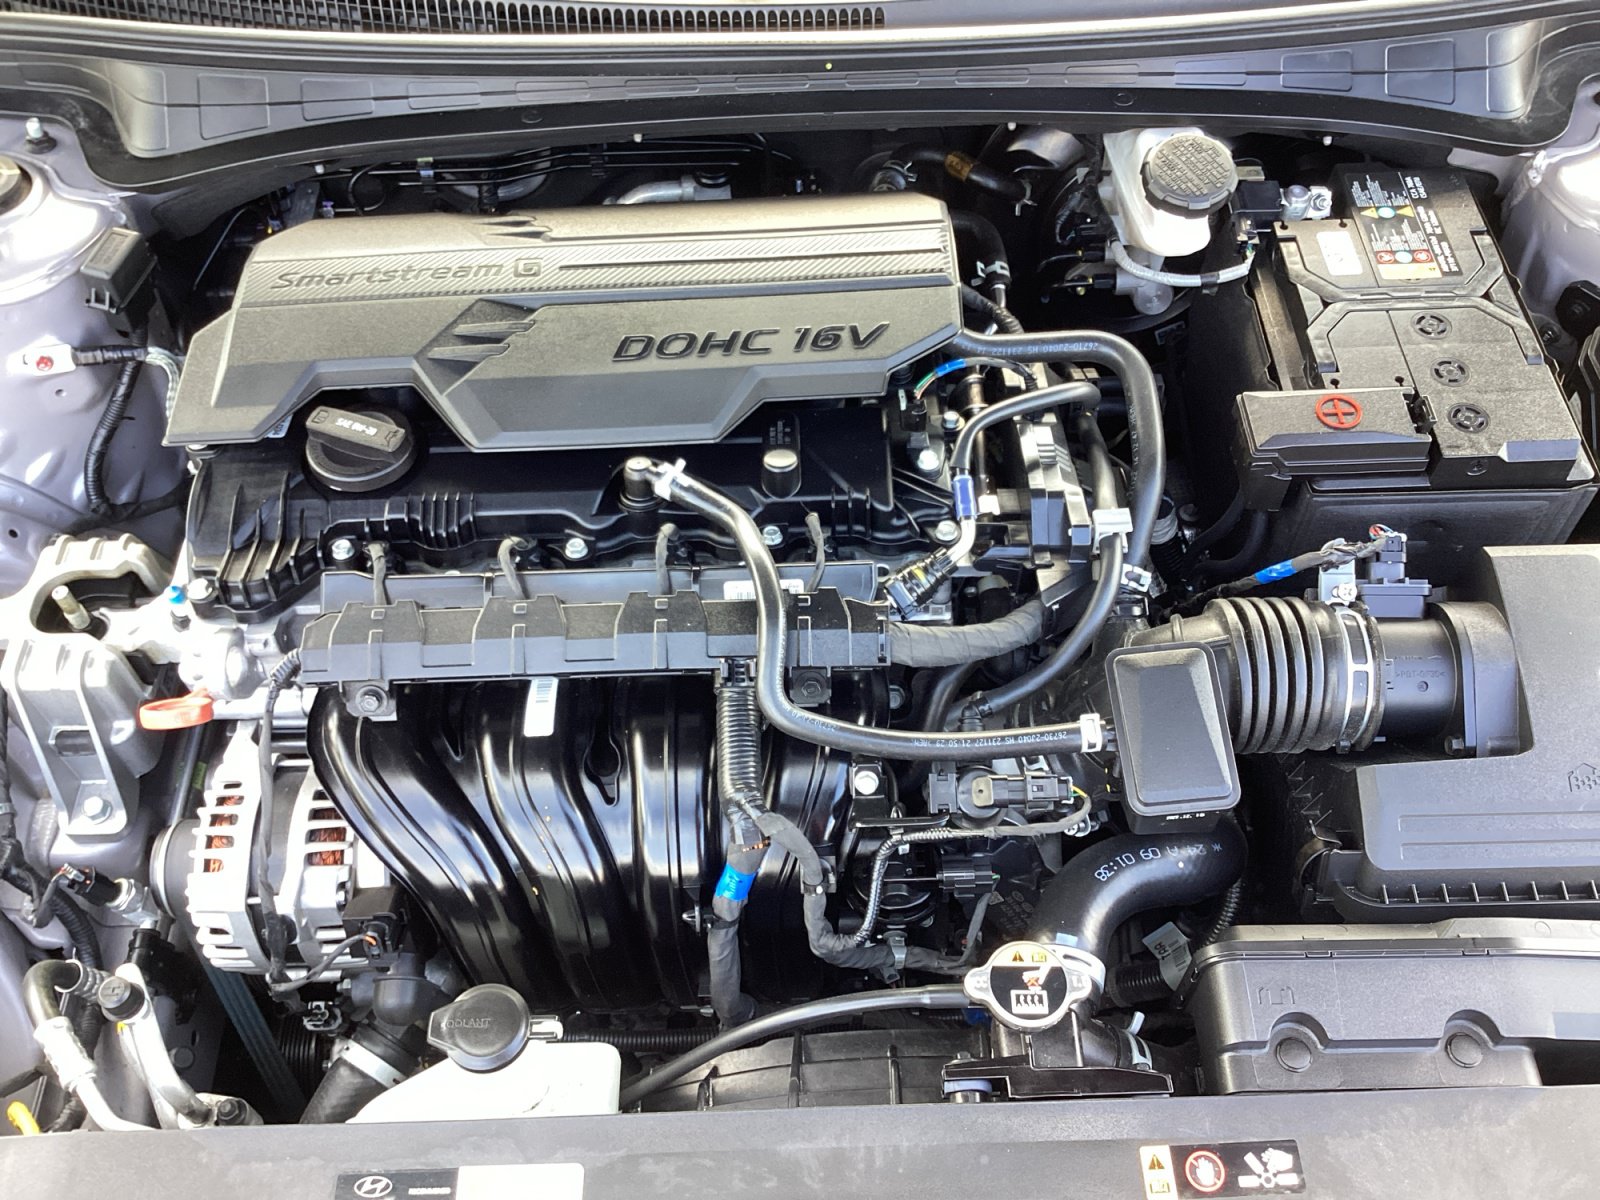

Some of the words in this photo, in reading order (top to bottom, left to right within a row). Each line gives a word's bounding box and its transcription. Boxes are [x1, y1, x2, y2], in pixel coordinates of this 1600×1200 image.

[270, 263, 504, 290] Smartstream
[611, 328, 780, 362] DOHC
[792, 321, 891, 352] 16V
[974, 738, 1001, 747] 231127
[1005, 737, 1015, 745] HS
[1018, 732, 1067, 744] 26730-2J040
[1139, 847, 1162, 861] 09
[1094, 853, 1136, 882] 01:38
